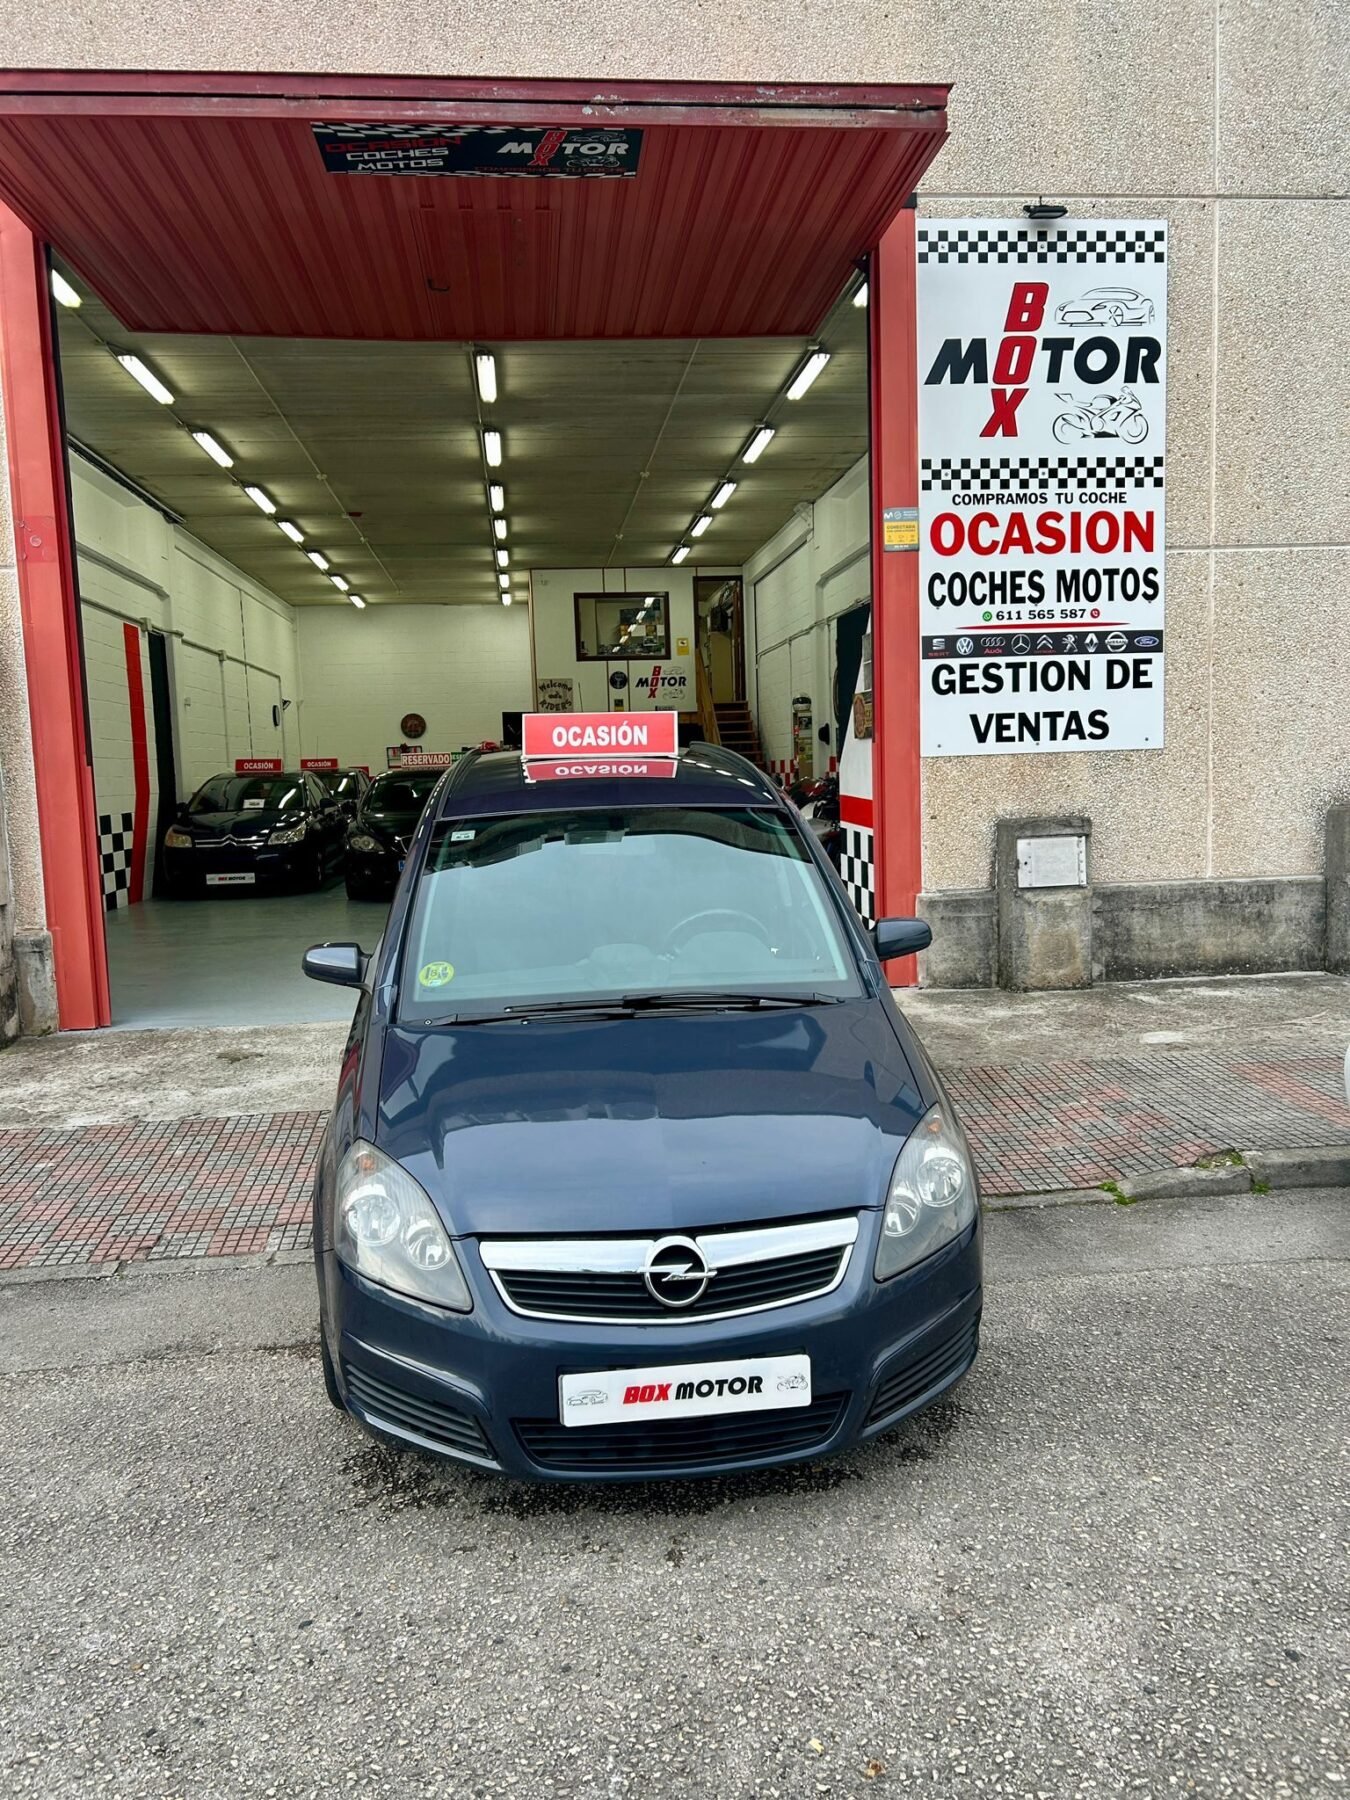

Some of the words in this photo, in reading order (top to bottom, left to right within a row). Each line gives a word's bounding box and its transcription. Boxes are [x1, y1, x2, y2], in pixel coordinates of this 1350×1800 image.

[325, 135, 462, 153] OCASION
[346, 147, 449, 160] COCHES
[357, 158, 444, 170] MOTOS
[924, 336, 1162, 385] MOTOR
[979, 282, 1049, 437] BOX
[952, 492, 1048, 506] COMPRAMOS
[1055, 493, 1074, 504] TU
[1078, 492, 1127, 504] COCHE
[930, 510, 1154, 556] OCASION
[927, 569, 1045, 607] COCHES
[1056, 567, 1160, 604] MOTOS
[996, 610, 1022, 621] 611
[1028, 609, 1055, 620] 565
[1060, 608, 1086, 619] 587
[635, 676, 687, 688] MOTOR
[648, 666, 662, 698] BOX
[931, 659, 1091, 695] GESTION
[1106, 658, 1153, 690] DE
[552, 721, 648, 747] OCASIÓN
[969, 709, 1110, 743] VENTAS
[243, 761, 274, 769] OCASIÓN
[402, 754, 450, 765] RESERVADO
[623, 1383, 672, 1405] BOX
[675, 1376, 763, 1400] MOTOR
